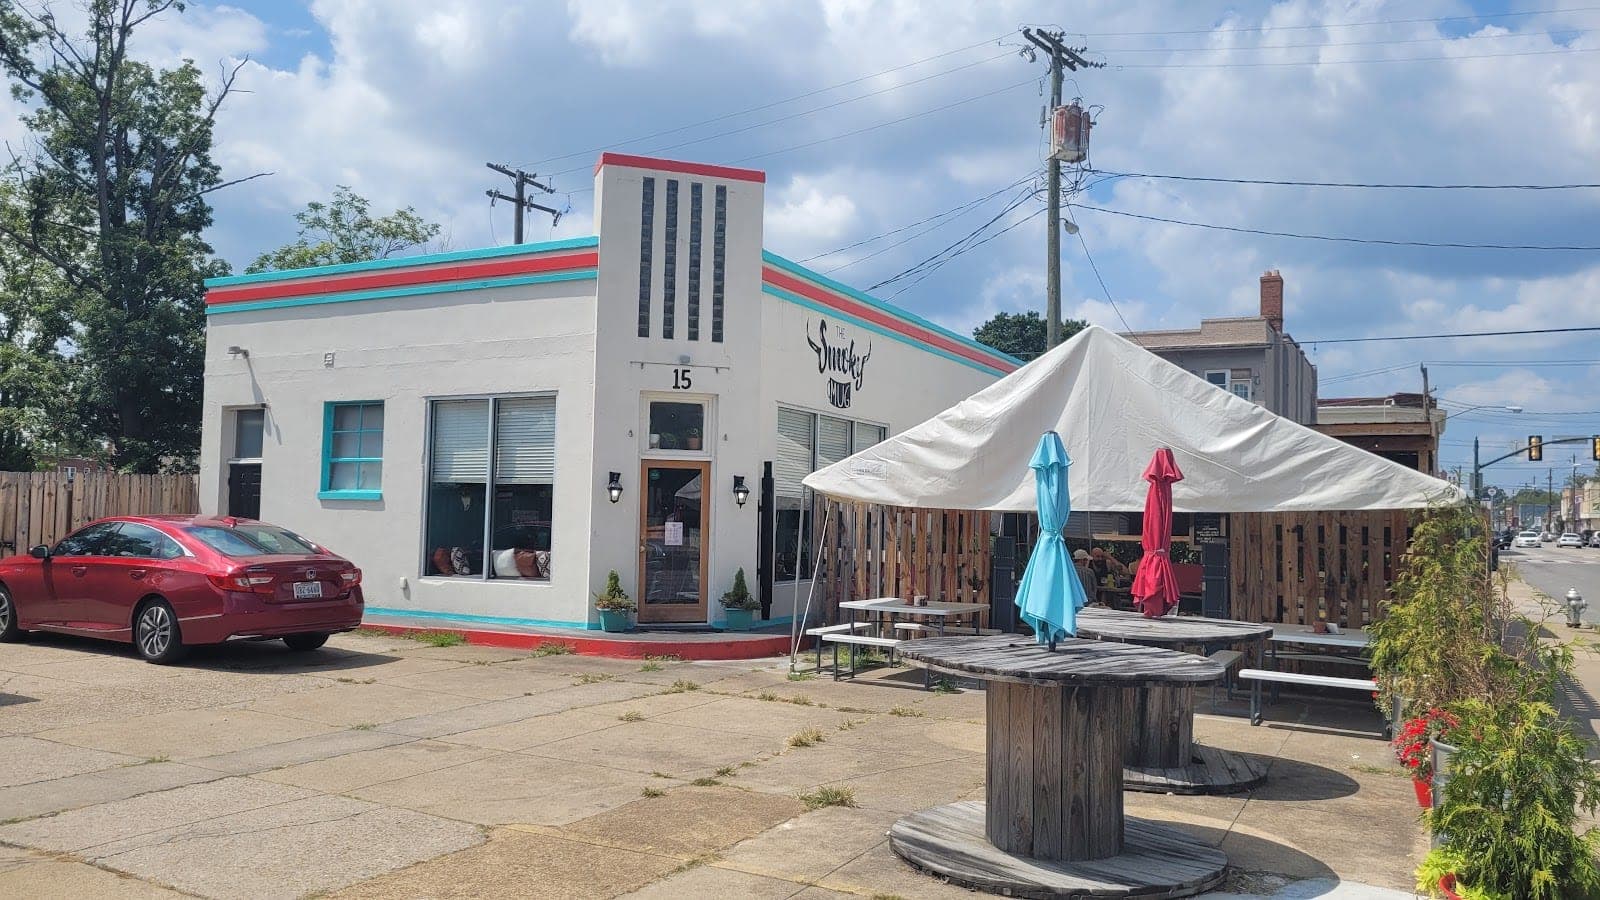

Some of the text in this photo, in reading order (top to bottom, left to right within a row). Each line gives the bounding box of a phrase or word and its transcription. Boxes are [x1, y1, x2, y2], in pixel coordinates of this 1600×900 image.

[835, 325, 846, 340] THE
[808, 318, 871, 391] Smoky
[672, 368, 692, 390] 15
[829, 377, 851, 409] MUG
